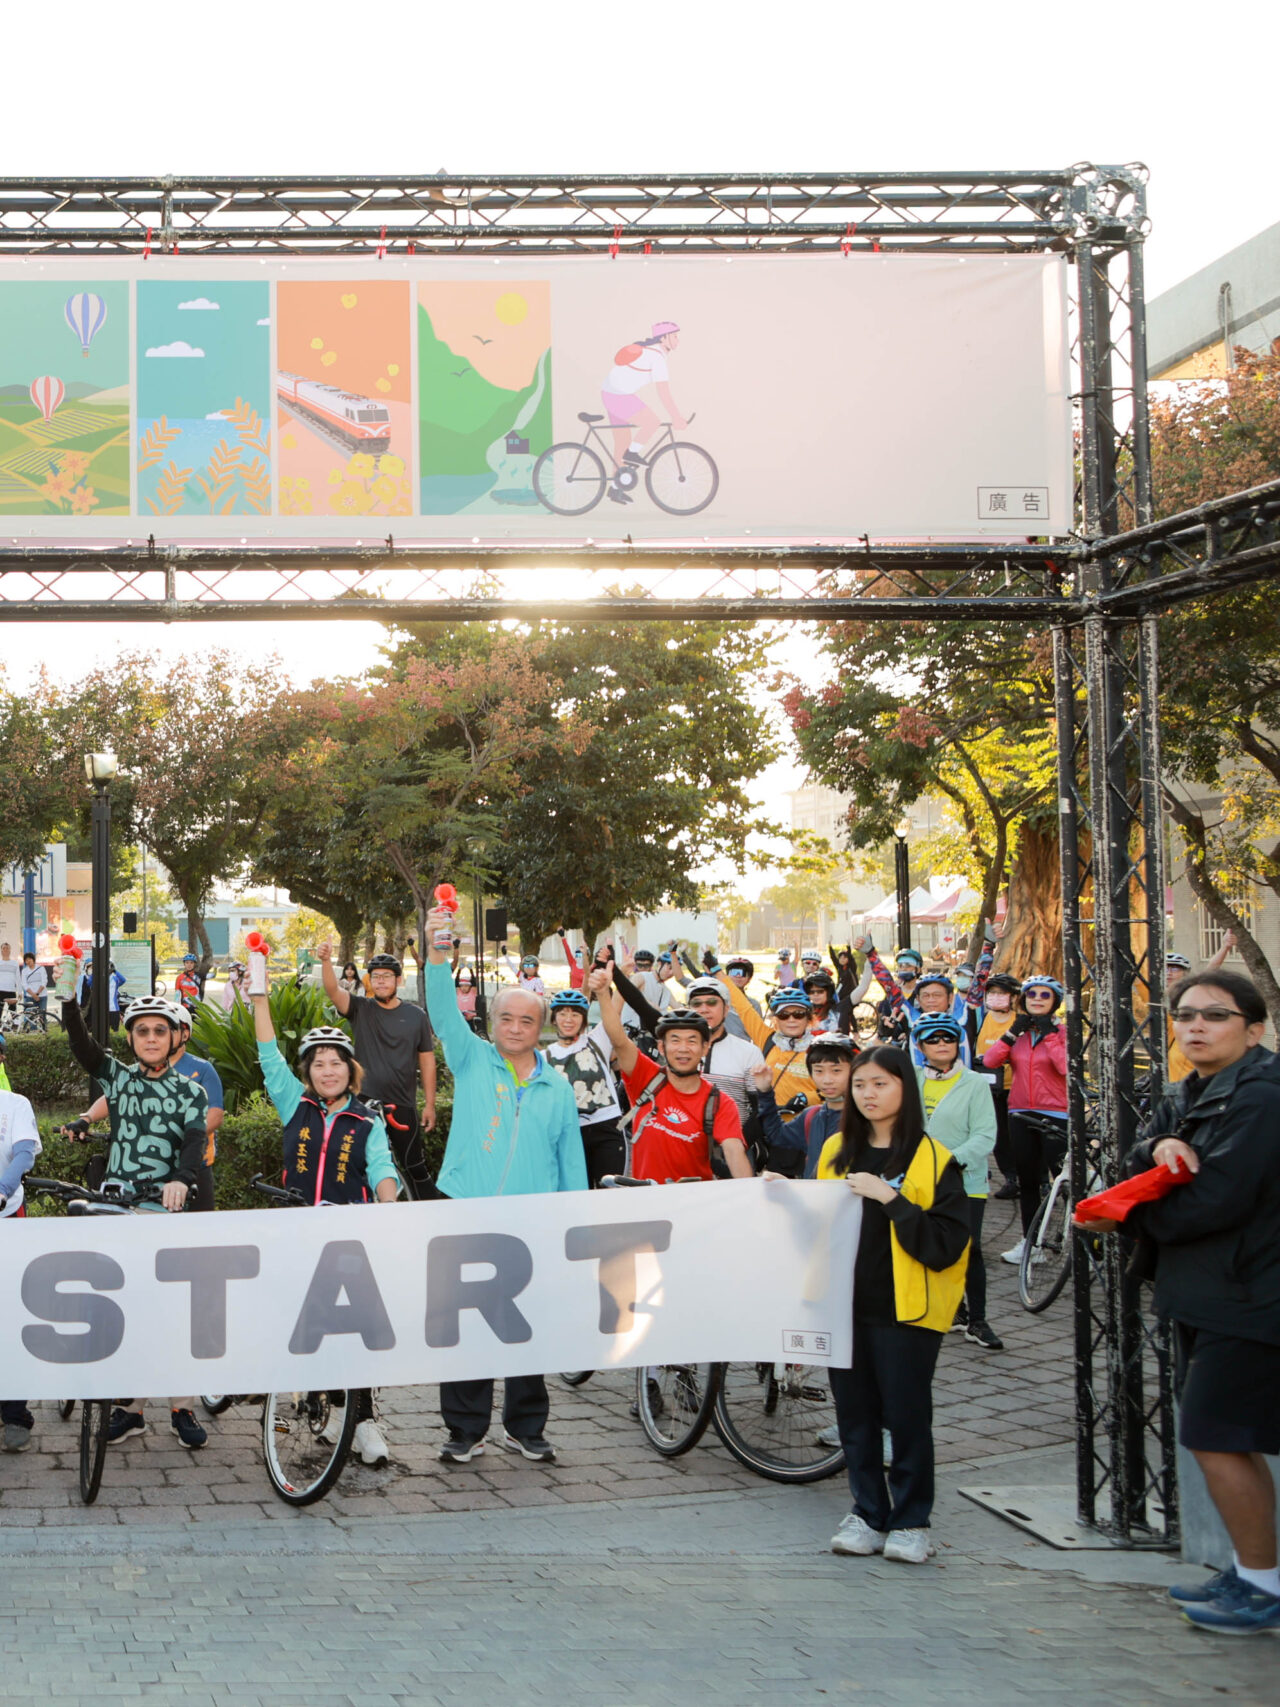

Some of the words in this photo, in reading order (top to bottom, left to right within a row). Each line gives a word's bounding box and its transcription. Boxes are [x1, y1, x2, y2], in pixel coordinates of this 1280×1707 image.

[989, 492, 1041, 512] 廣告
[19, 1219, 673, 1364] START
[791, 1335, 827, 1350] 廣告
